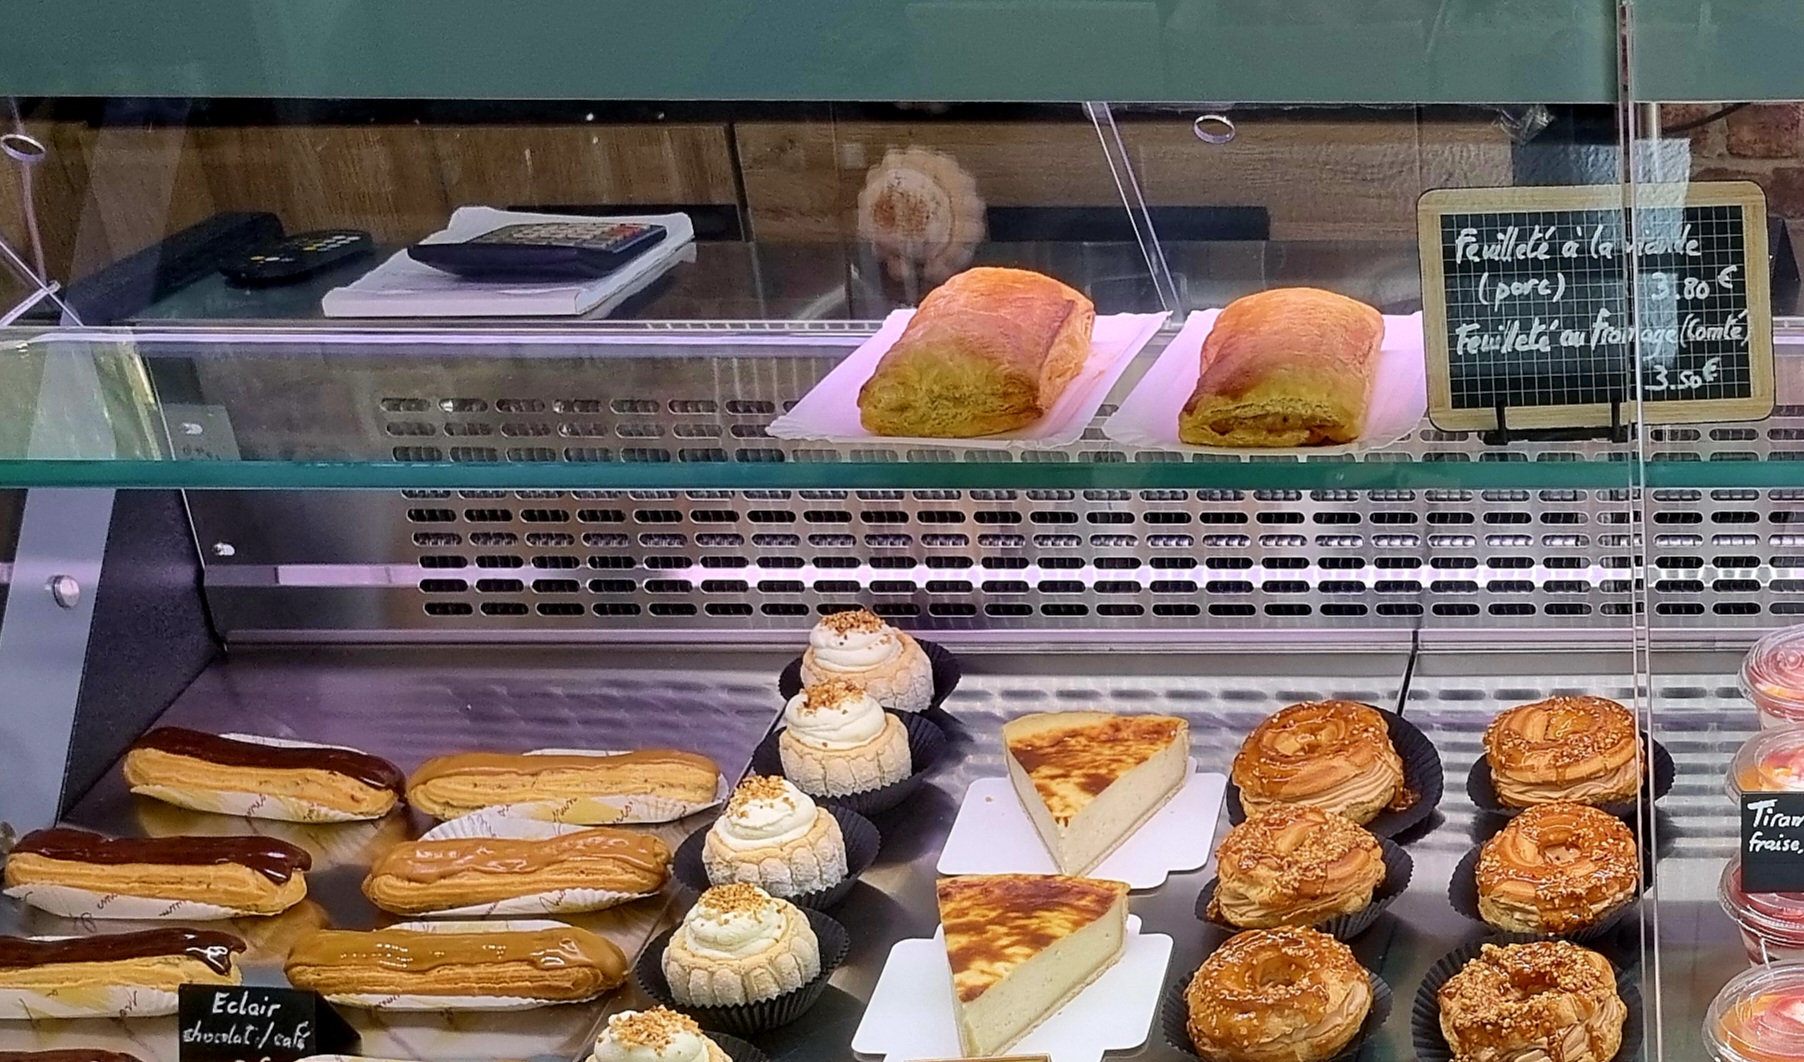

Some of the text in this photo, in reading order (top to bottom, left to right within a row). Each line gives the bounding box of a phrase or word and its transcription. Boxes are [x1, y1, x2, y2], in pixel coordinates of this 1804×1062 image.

[1455, 225, 1555, 264] Feuilleté
[1561, 226, 1584, 258] à
[1590, 224, 1615, 259] la
[1478, 271, 1566, 312] (porc)
[1455, 317, 1559, 355] Feuilleté
[1560, 327, 1585, 348] au
[212, 991, 281, 1017] Eclair
